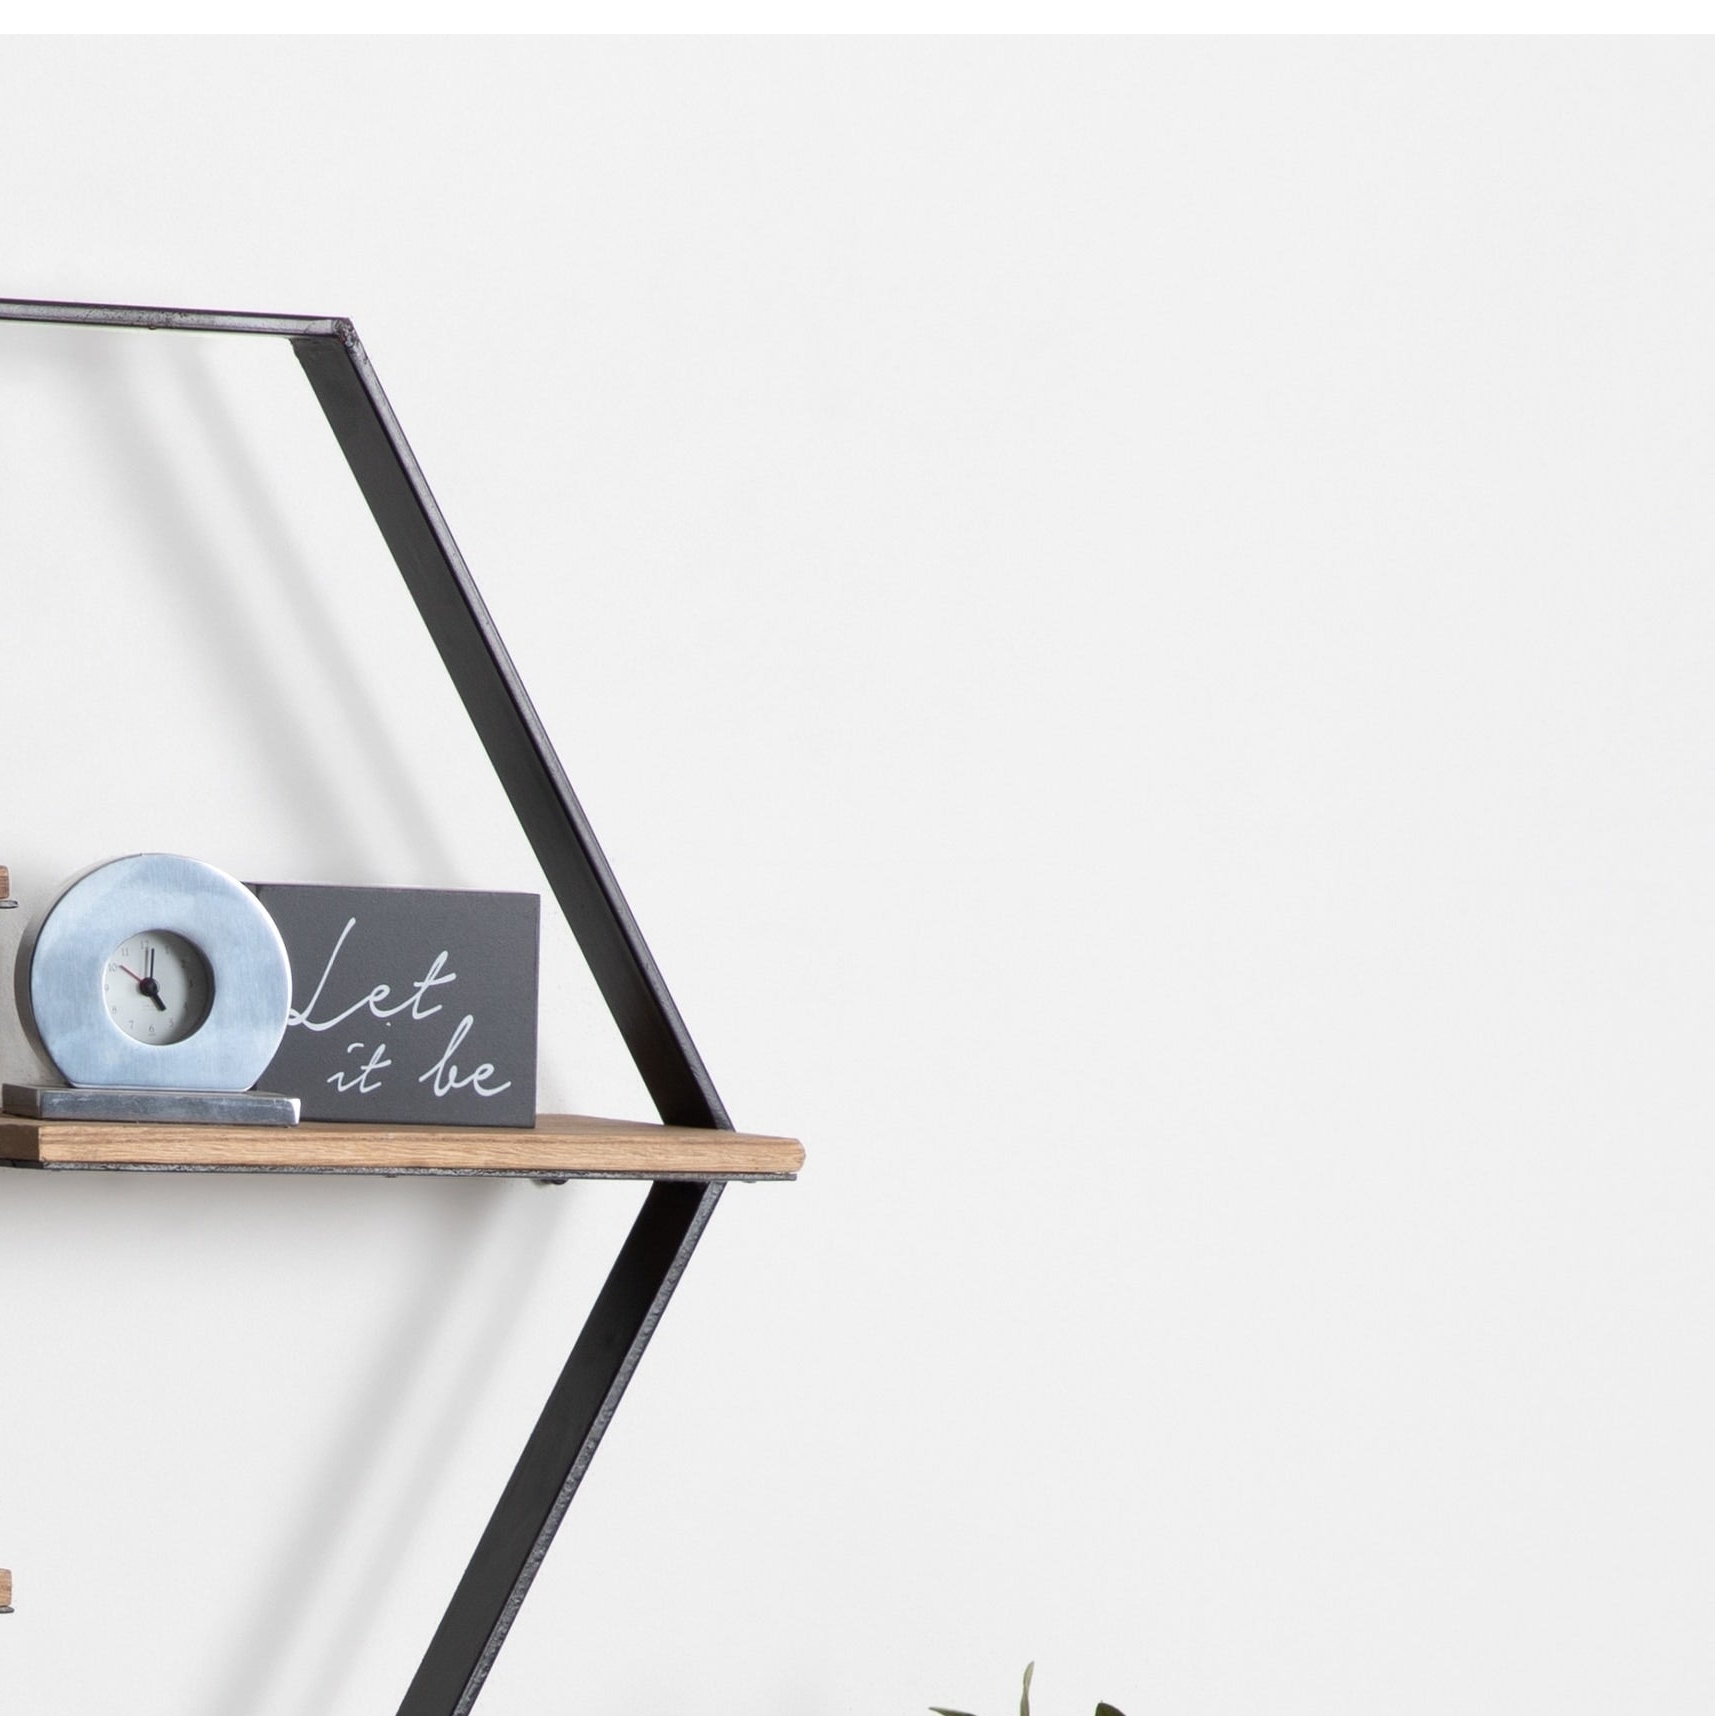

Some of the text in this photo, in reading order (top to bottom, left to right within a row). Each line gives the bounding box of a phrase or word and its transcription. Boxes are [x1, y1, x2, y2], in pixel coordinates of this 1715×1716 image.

[108, 963, 118, 972] 10
[121, 947, 129, 957] 11
[287, 916, 456, 1031] Let
[327, 1014, 512, 1097] it be
